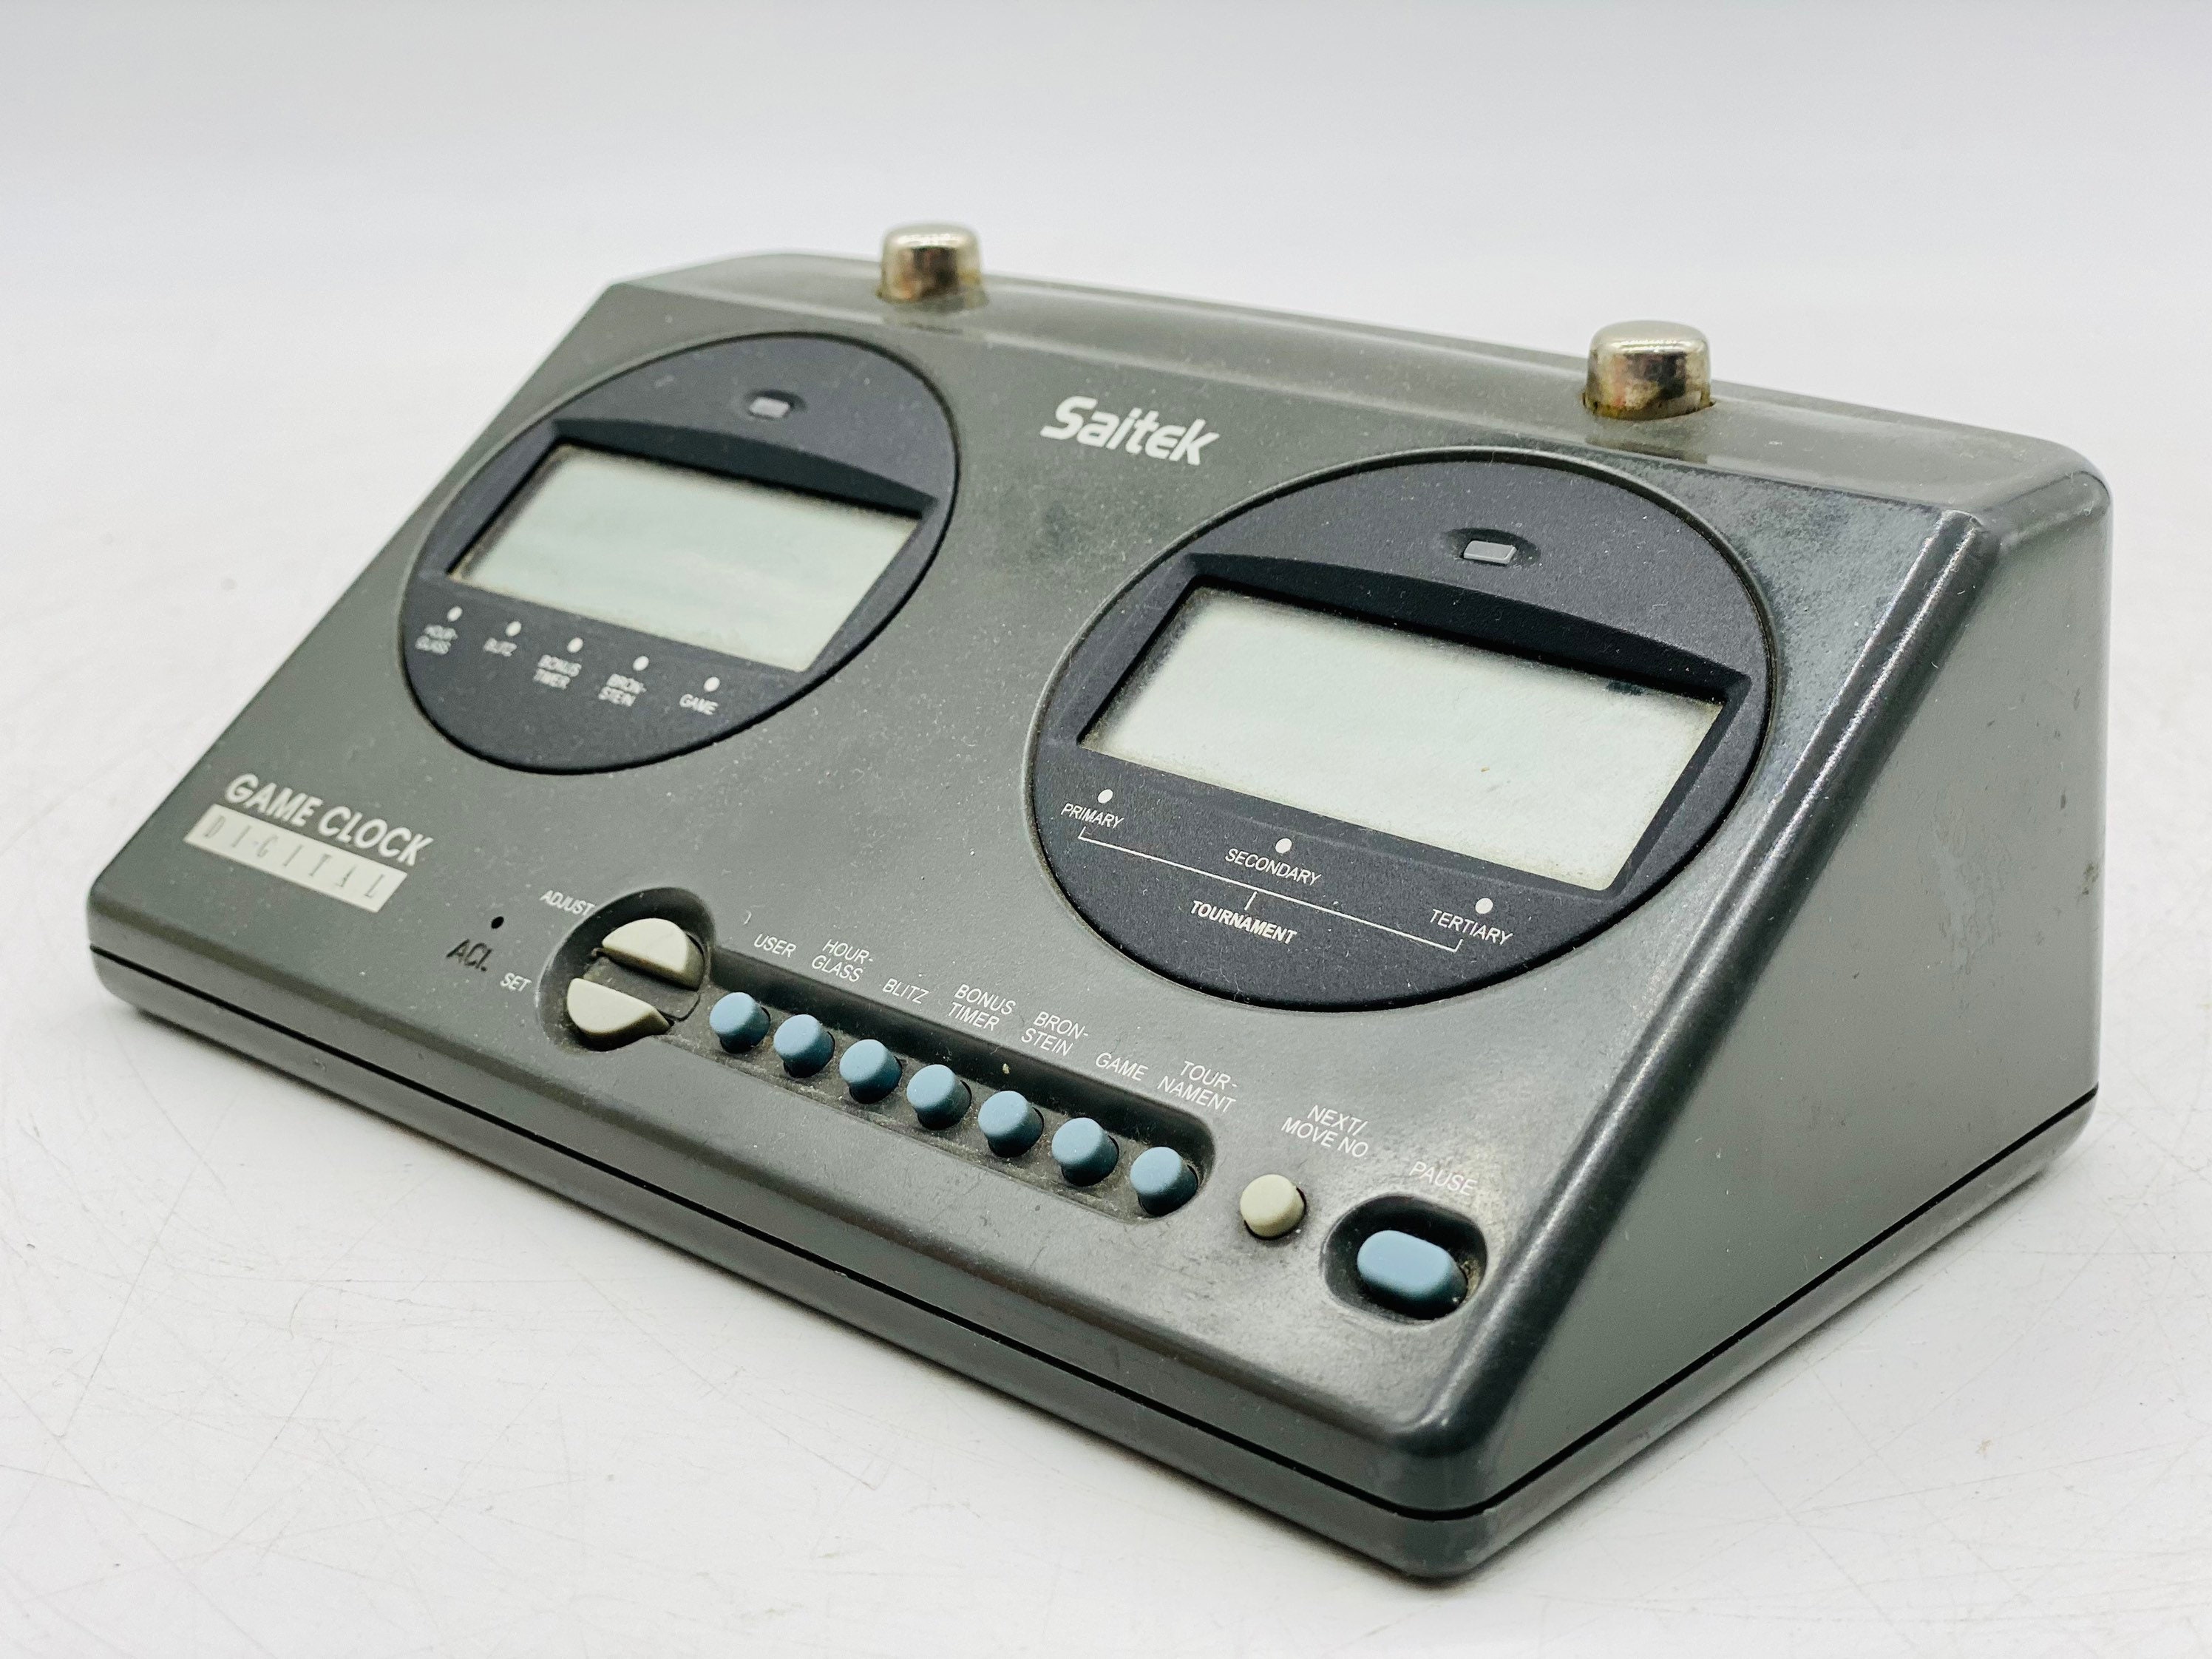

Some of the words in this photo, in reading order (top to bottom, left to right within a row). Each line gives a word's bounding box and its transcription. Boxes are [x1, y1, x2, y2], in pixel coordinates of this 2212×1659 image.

[1040, 396, 1220, 466] Saitek
[225, 773, 323, 827] GAME
[318, 806, 434, 866] CLOCK
[1060, 803, 1124, 830] PRIMARY
[1224, 848, 1322, 886] SECONDARY
[540, 889, 597, 916] ADJUST
[1190, 900, 1297, 945] TOURNAMENT
[1431, 908, 1513, 946] TERTIARY
[753, 933, 797, 958] USER
[822, 938, 874, 964] HOUR-
[500, 972, 532, 991] SET
[811, 955, 864, 983] GLASS
[882, 977, 930, 1004] BLITZ
[954, 984, 1017, 1015] BONUS
[948, 1002, 1000, 1031] TIMER
[1033, 1011, 1089, 1039] BRON-
[1021, 1028, 1074, 1057] STEIN
[1095, 1052, 1149, 1082] GAME
[1180, 1060, 1238, 1090] TOUR-
[1157, 1076, 1237, 1113] NAMENT
[1280, 1116, 1339, 1148] MOVE
[1307, 1105, 1368, 1136] NEXT/
[1409, 1161, 1478, 1197] PAUSE
